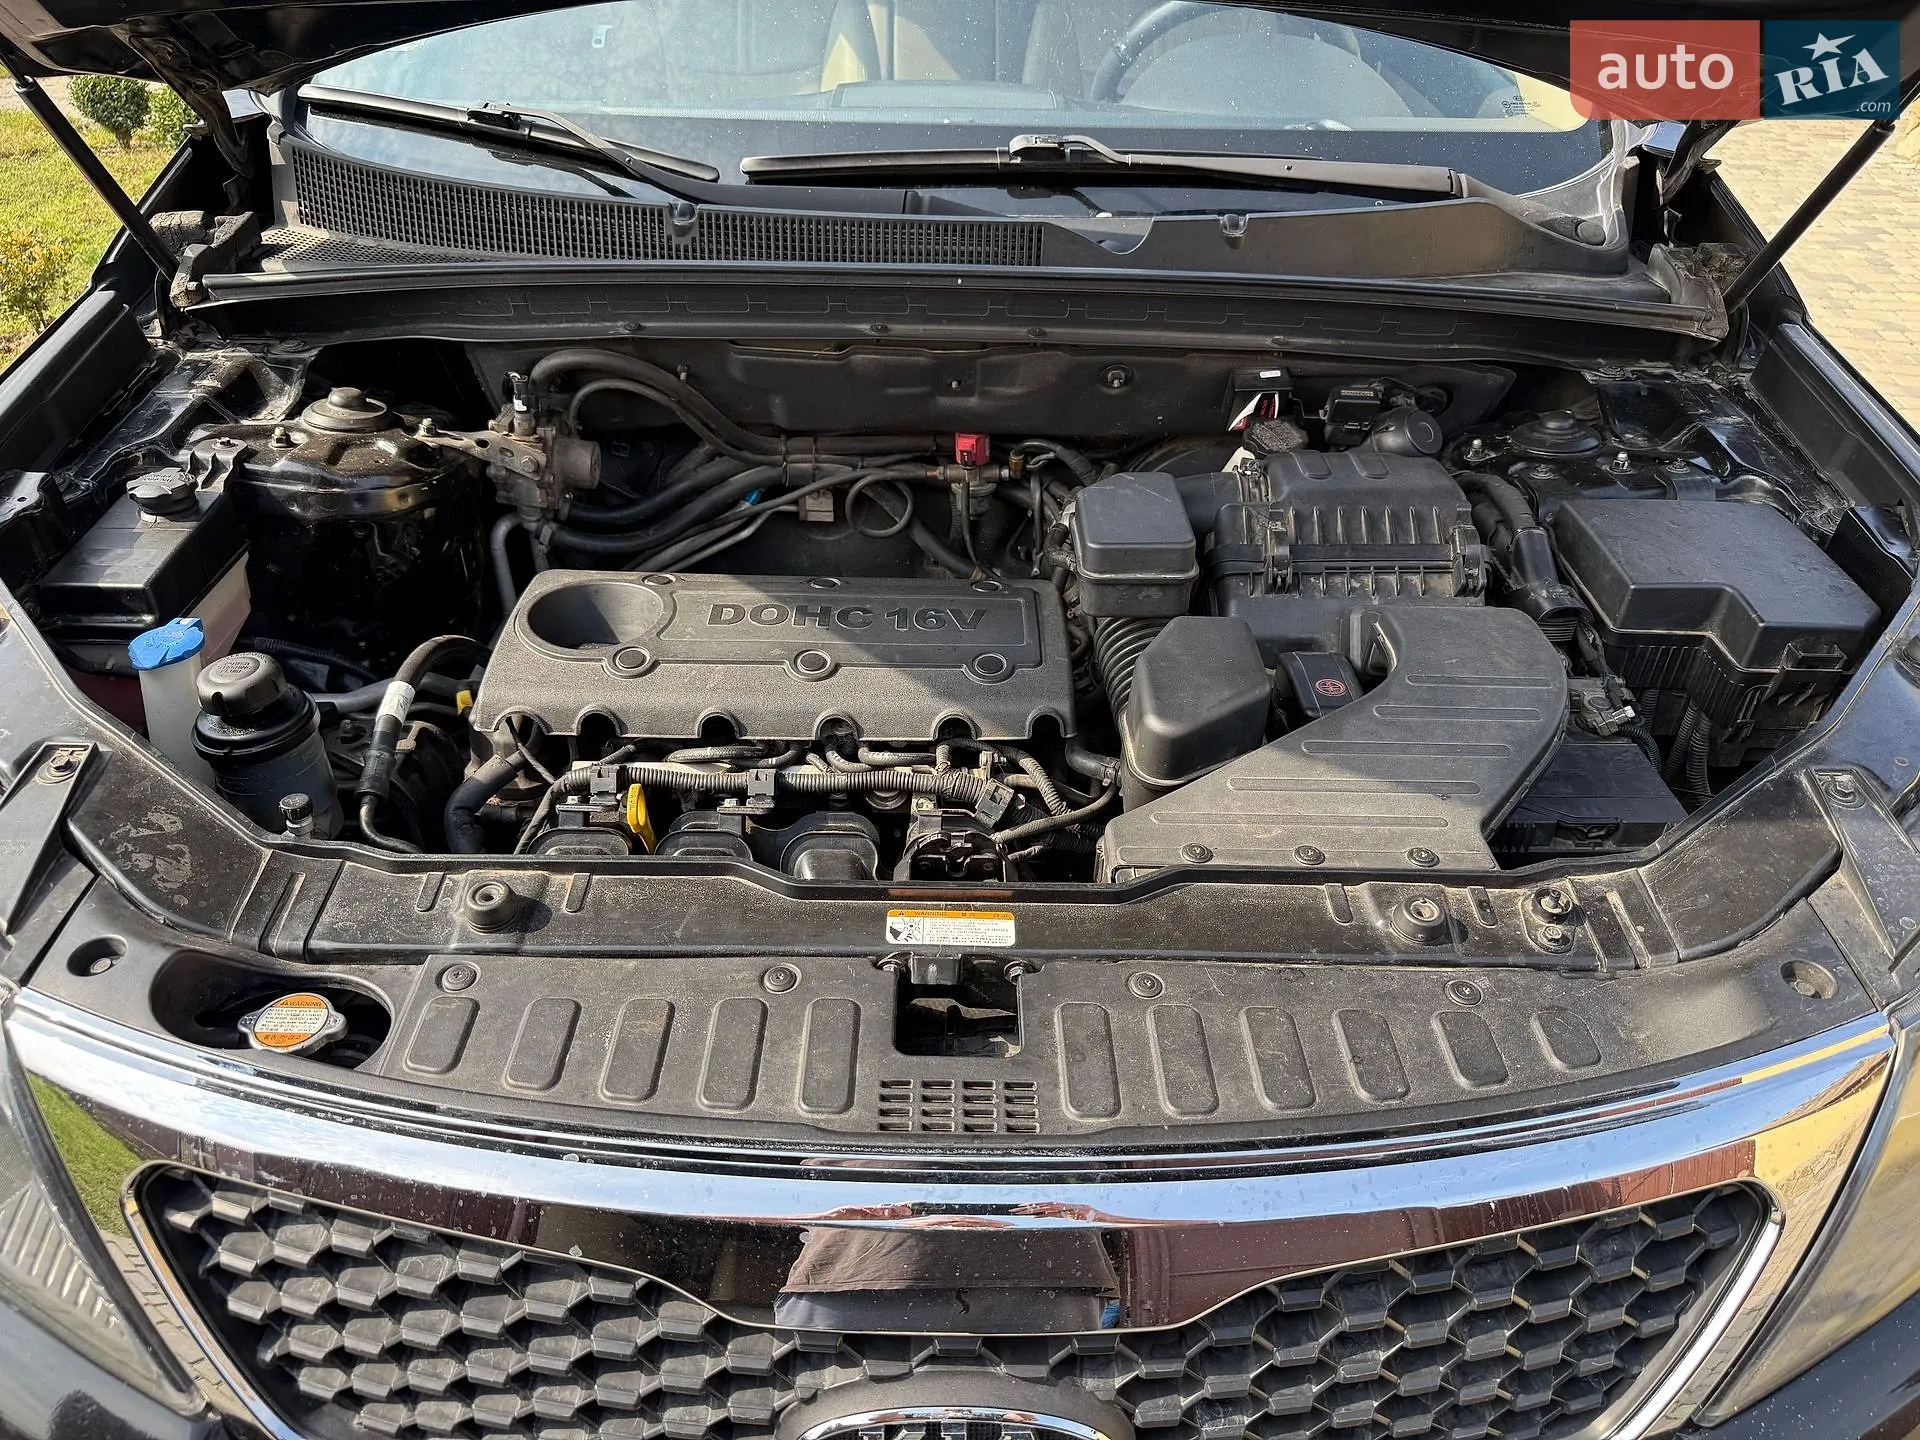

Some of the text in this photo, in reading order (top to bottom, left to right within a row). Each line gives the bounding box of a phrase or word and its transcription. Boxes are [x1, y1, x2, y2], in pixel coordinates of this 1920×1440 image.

[706, 603, 988, 631] DOHC 16V
[289, 1000, 322, 1008] WARNING
